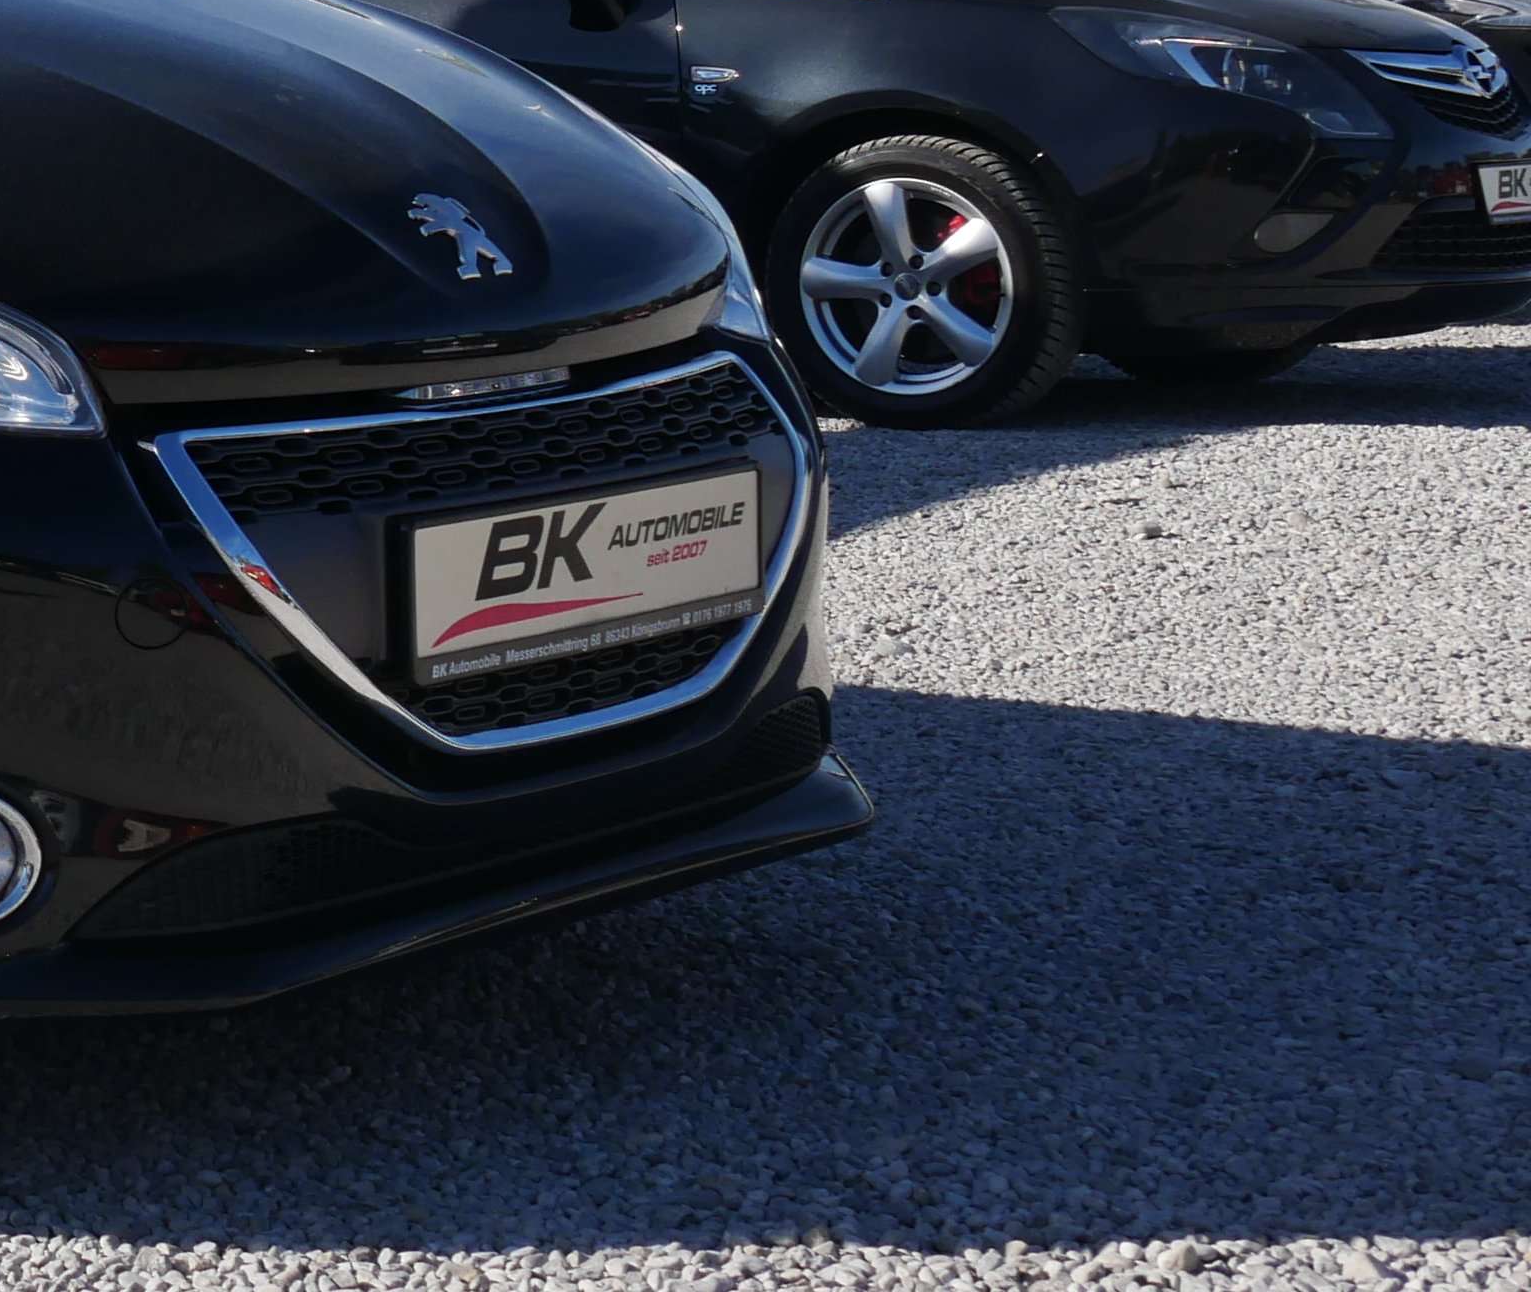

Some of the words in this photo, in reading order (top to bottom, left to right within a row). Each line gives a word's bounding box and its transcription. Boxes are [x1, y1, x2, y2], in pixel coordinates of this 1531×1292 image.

[1499, 168, 1528, 198] BK
[607, 501, 745, 550] AUTOMOBILE
[475, 502, 607, 601] BK
[646, 548, 670, 567] seit
[672, 540, 707, 562] 2007
[432, 662, 448, 678] BK
[449, 654, 501, 675] Automobile
